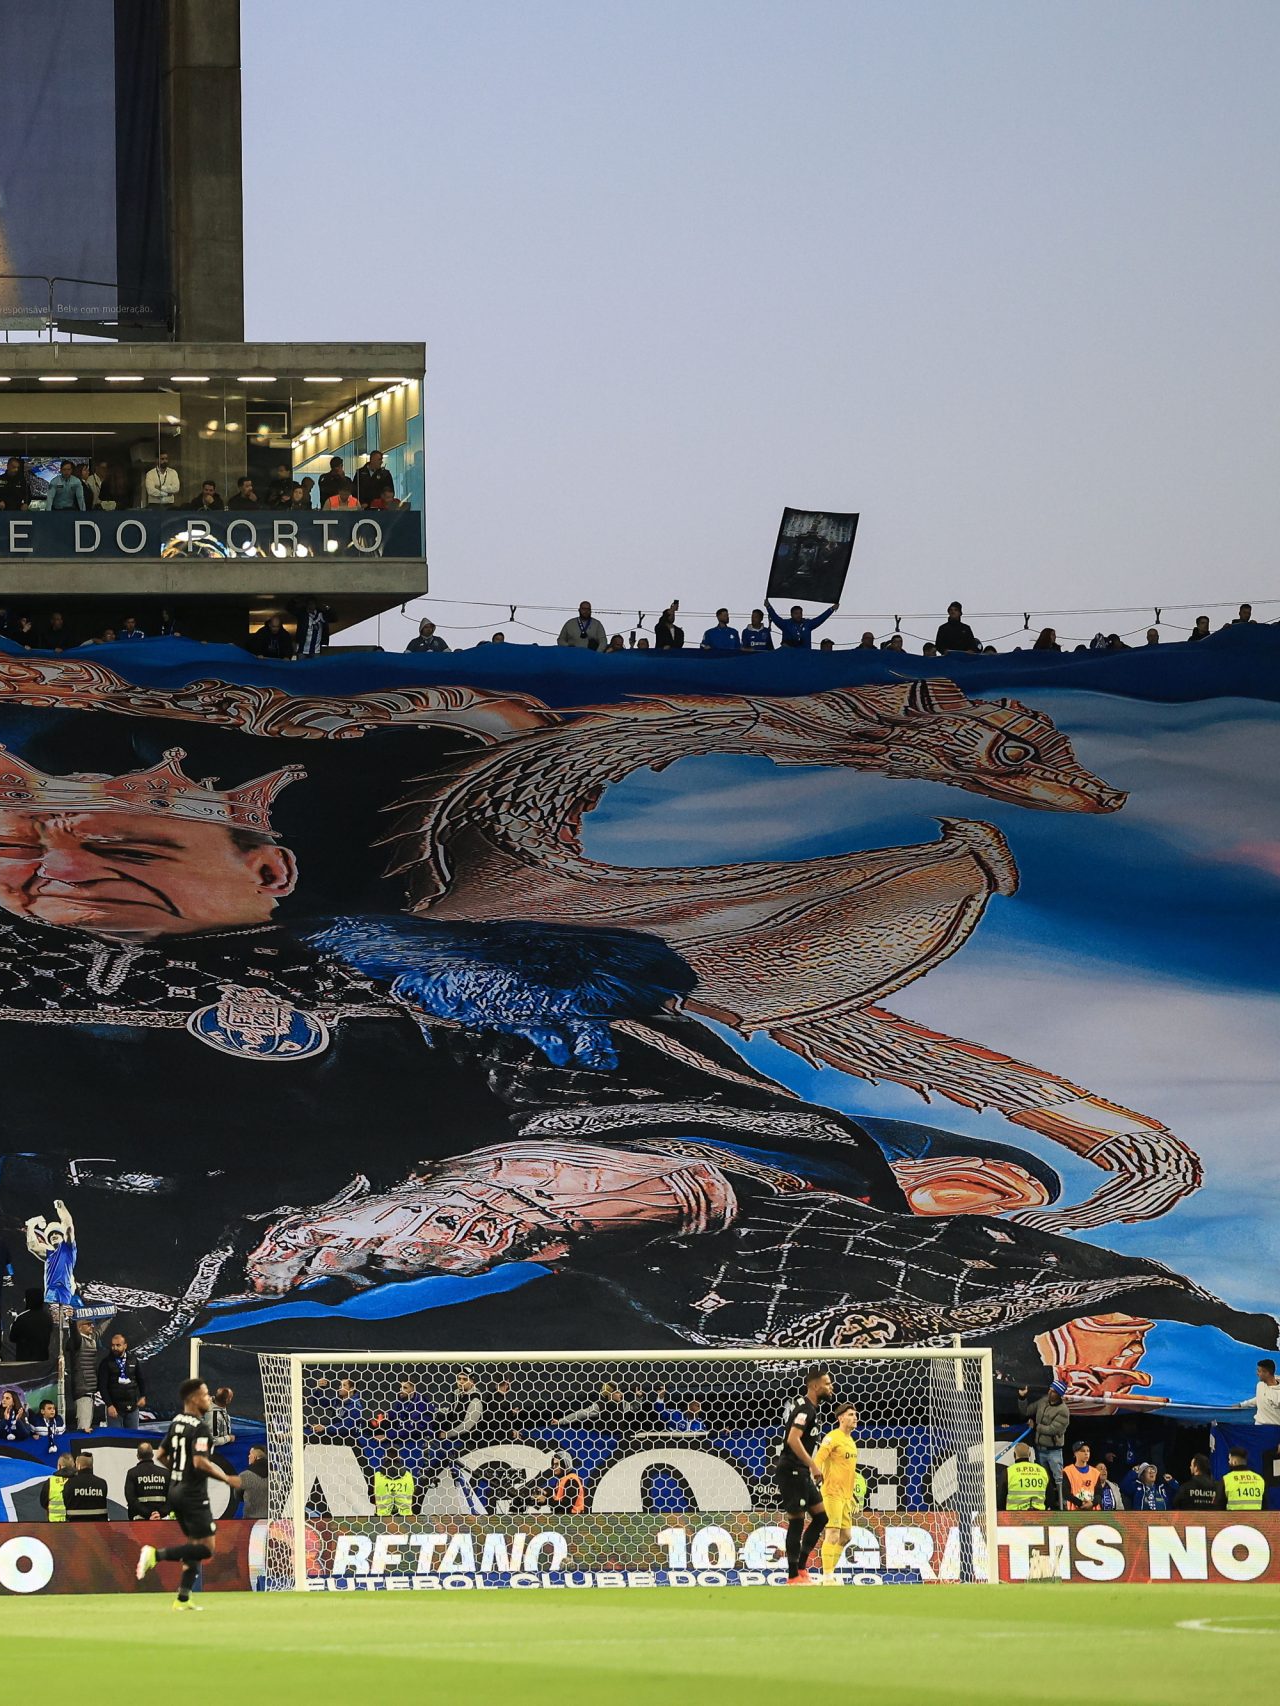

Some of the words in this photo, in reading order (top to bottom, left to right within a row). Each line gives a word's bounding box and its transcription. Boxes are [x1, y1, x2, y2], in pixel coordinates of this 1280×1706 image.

[81, 306, 100, 314] com
[74, 519, 148, 553] DO
[186, 518, 384, 553] PORTO
[136, 1473, 166, 1484] POLÍCIA
[1019, 1478, 1043, 1488] 1309
[74, 1486, 104, 1497] POLÍCIA
[384, 1483, 408, 1492] 1221
[1236, 1487, 1261, 1498] 1403
[332, 1531, 570, 1575] BETANO
[832, 1510, 1126, 1585] GRÁTIS
[1147, 1524, 1271, 1581] NO
[304, 1574, 500, 1592] FUTEBOL
[509, 1571, 657, 1589] CLUBE
[668, 1570, 729, 1587] DO
